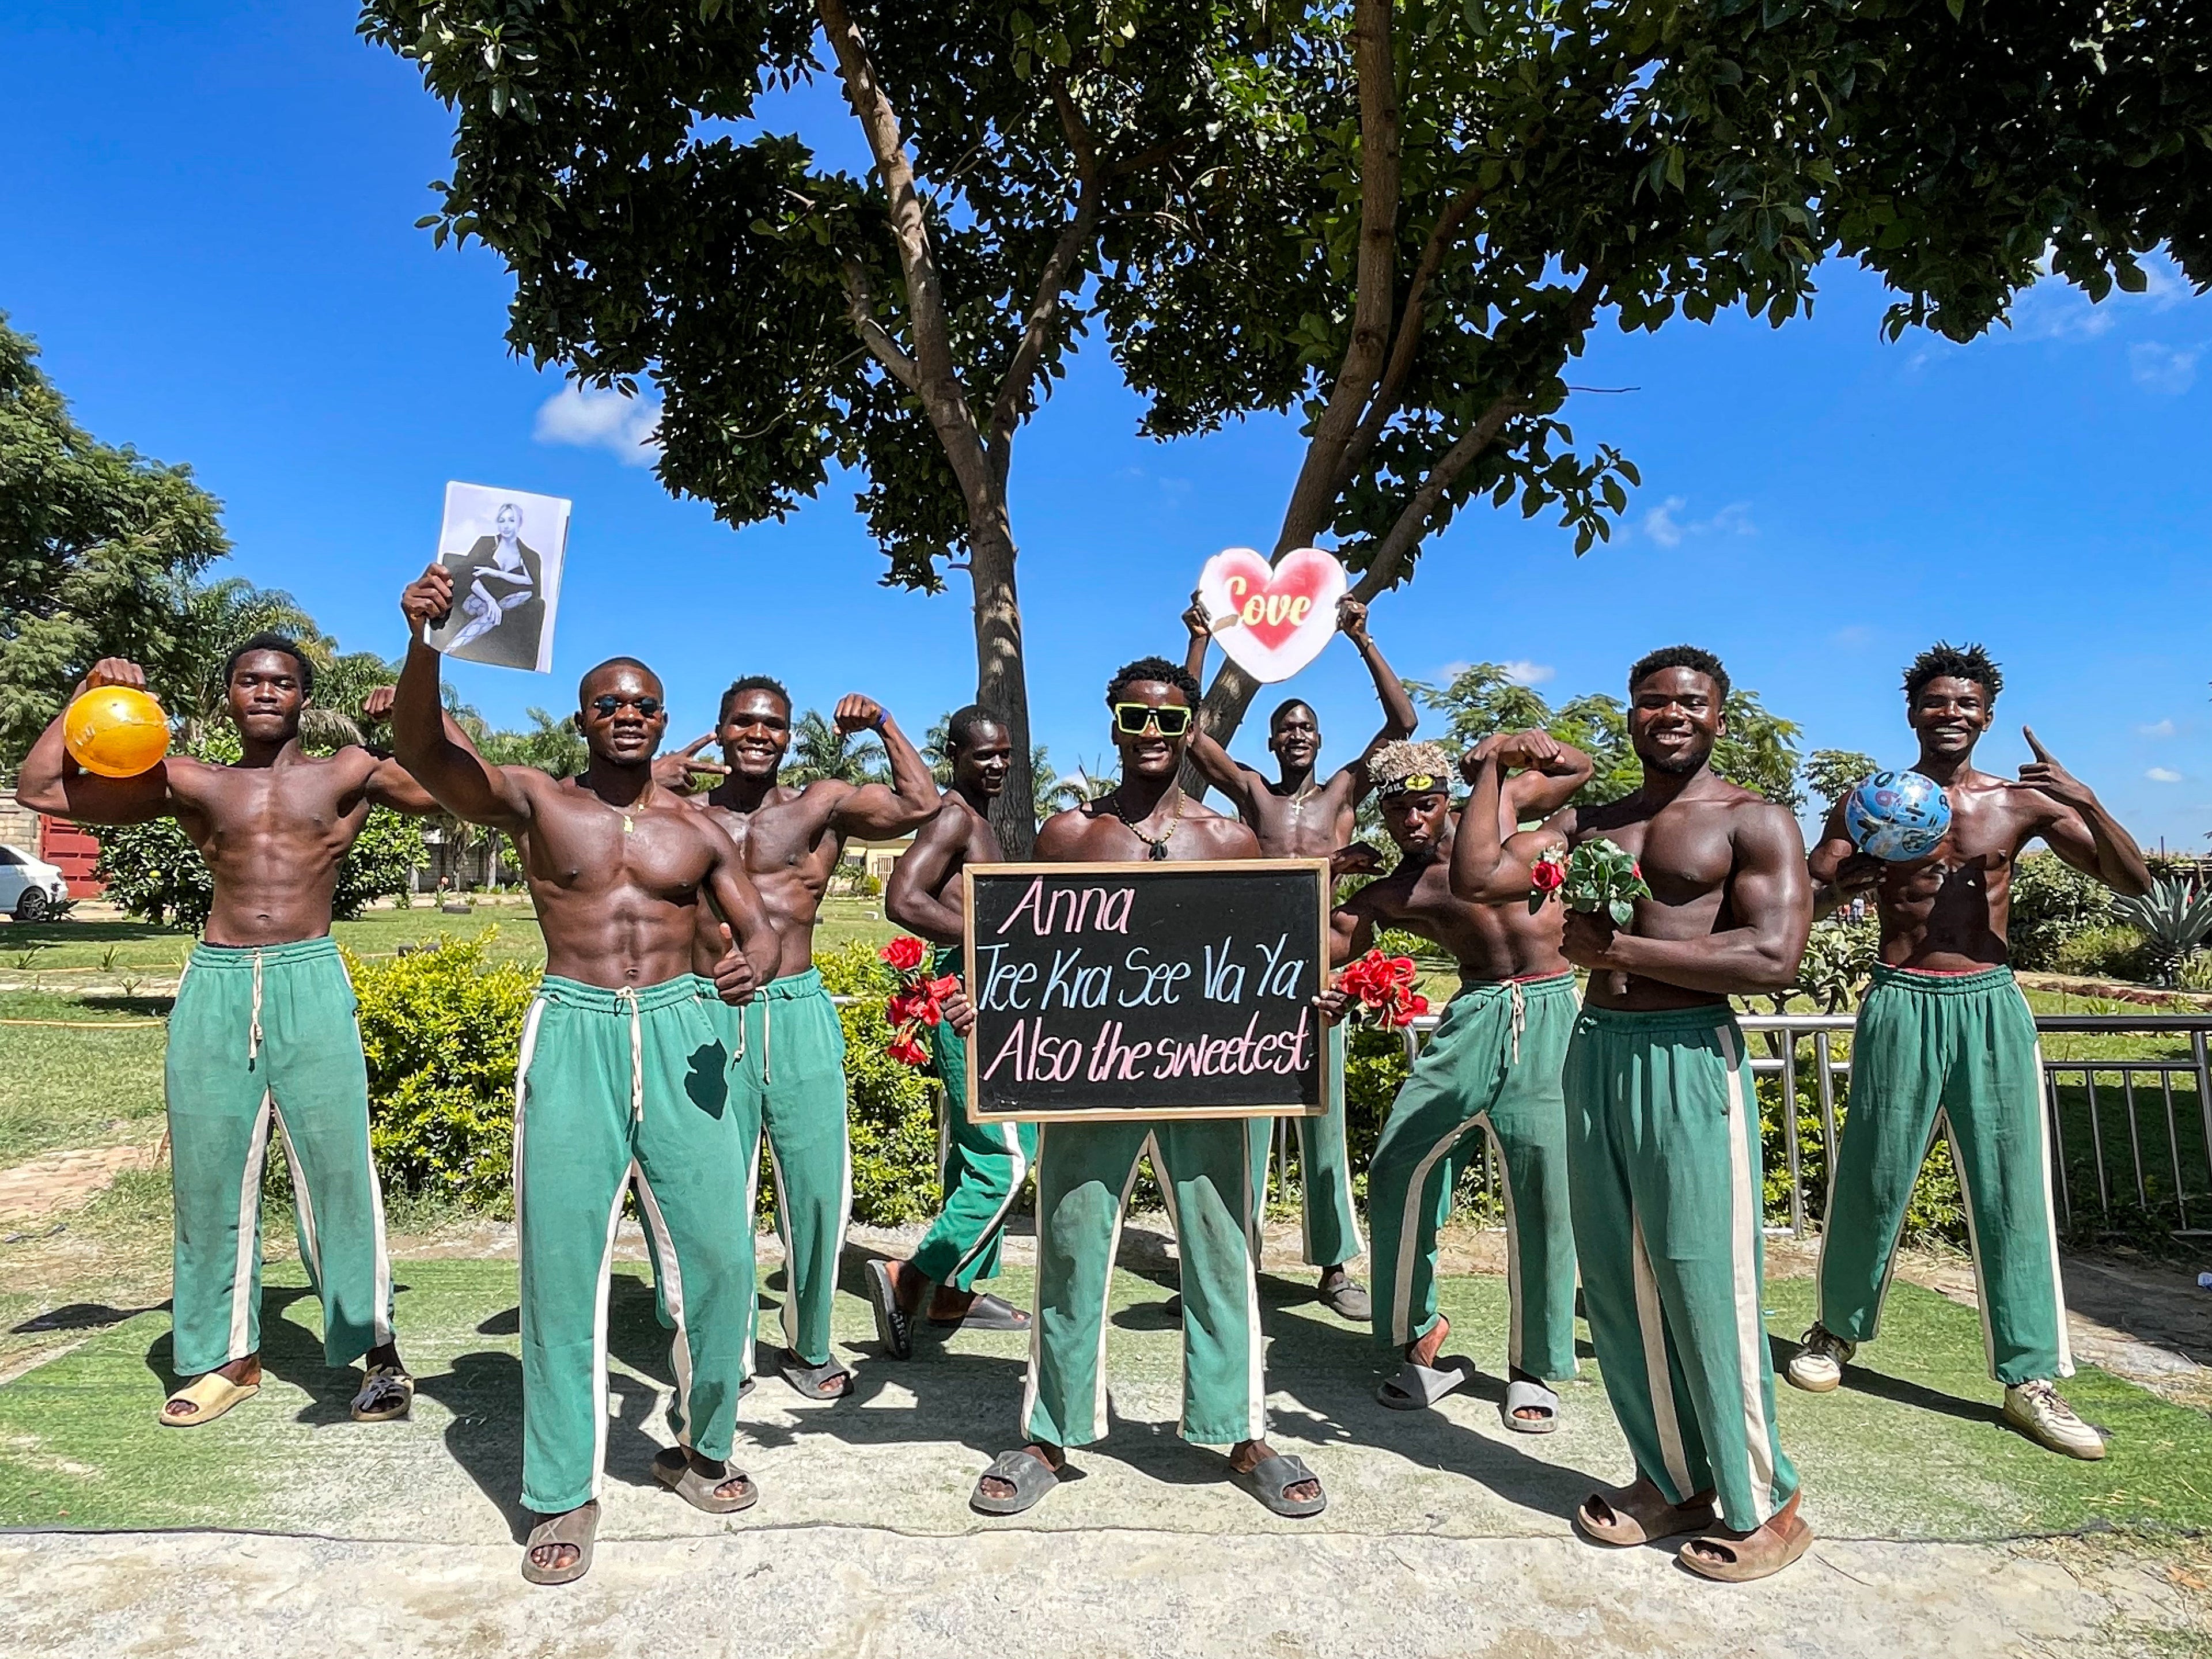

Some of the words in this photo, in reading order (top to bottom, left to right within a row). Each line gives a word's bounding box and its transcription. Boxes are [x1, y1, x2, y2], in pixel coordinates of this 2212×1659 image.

[997, 876, 1134, 935] Anna
[977, 943, 1037, 1011] Tee
[1040, 948, 1112, 1010] Kra
[1118, 948, 1191, 1007] See
[1205, 937, 1245, 1003] Va
[1256, 934, 1303, 999] Ya
[983, 1017, 1082, 1081] Also
[1088, 1020, 1152, 1081] the
[1153, 1006, 1309, 1079] sweetest
